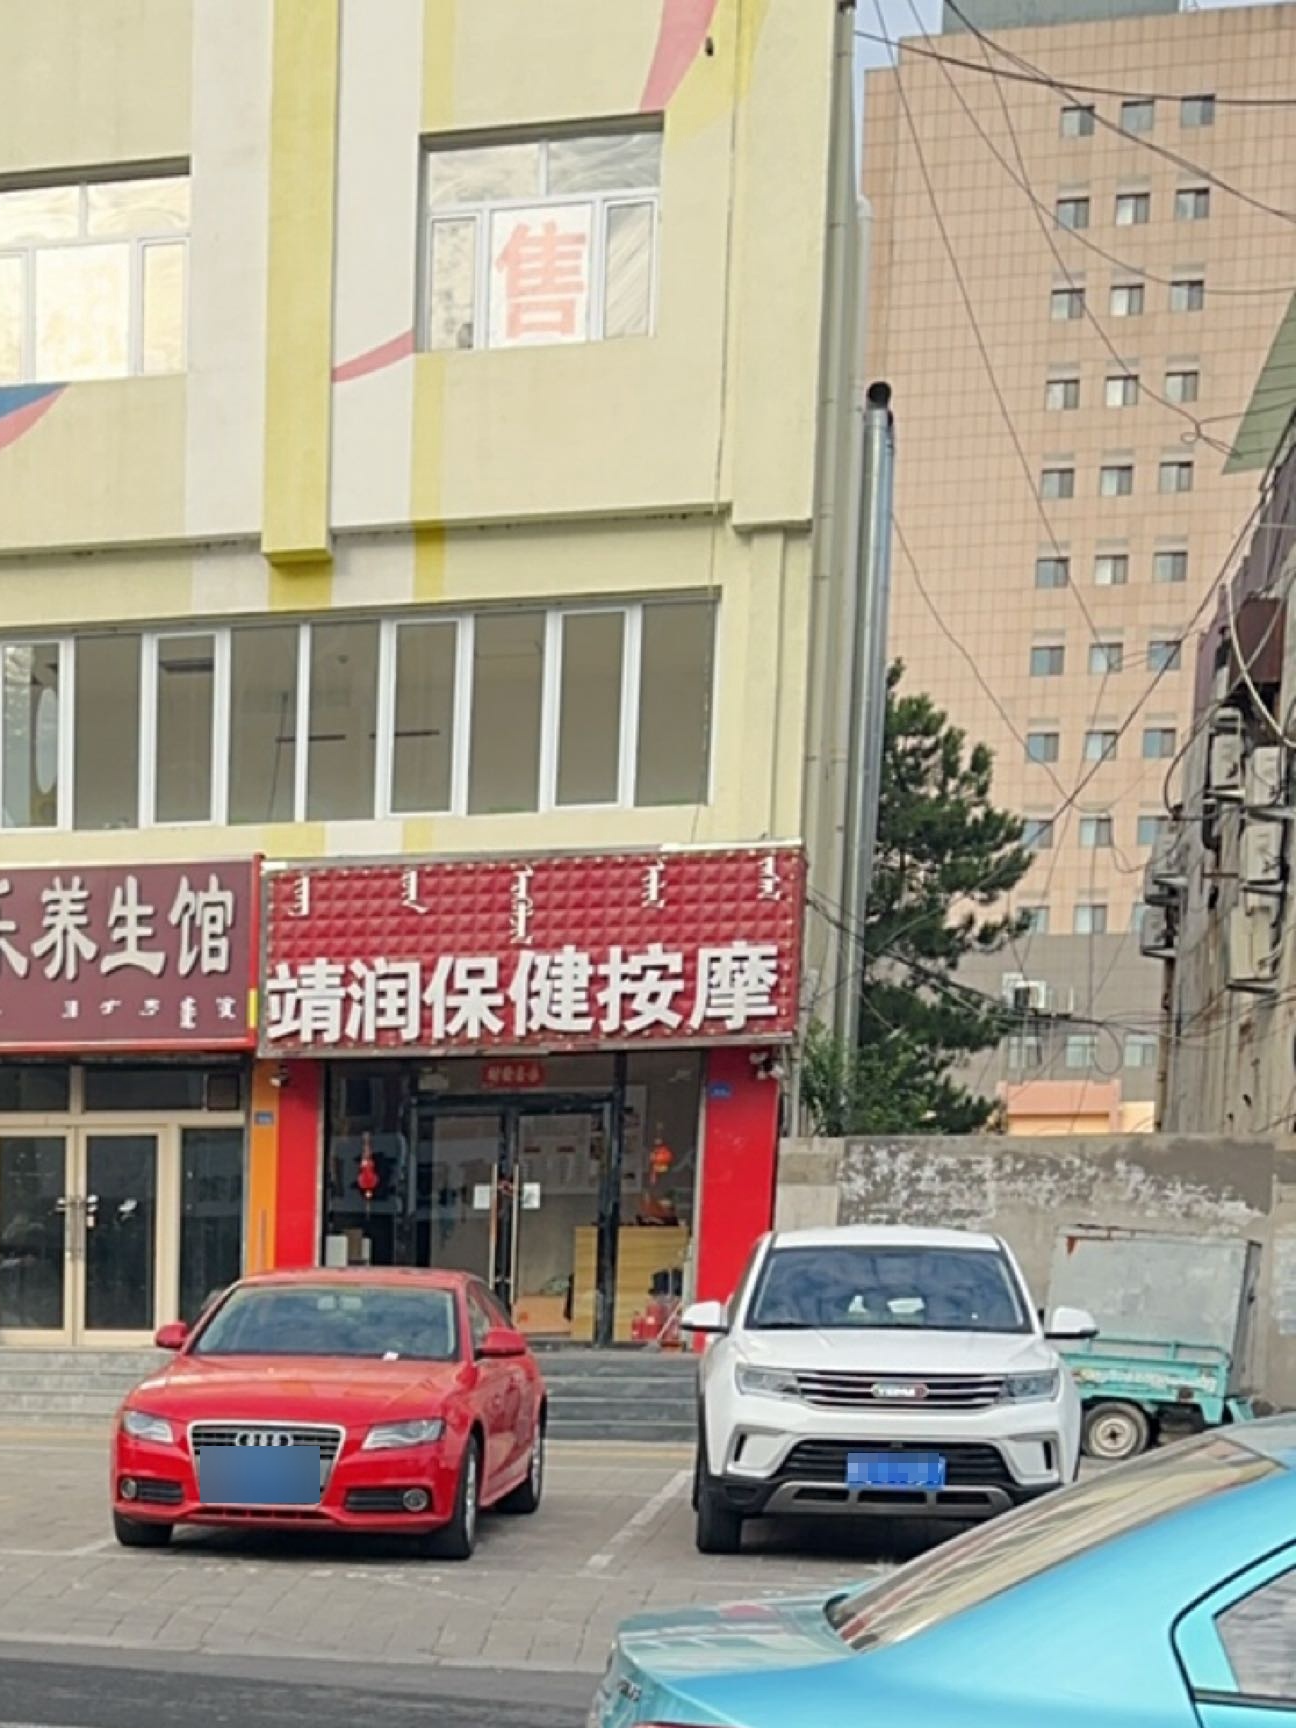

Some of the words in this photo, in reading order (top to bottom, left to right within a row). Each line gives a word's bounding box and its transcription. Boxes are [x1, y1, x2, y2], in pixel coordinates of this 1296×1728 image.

[495, 218, 587, 340] 售
[266, 941, 779, 1043] 靖润保健按摩
